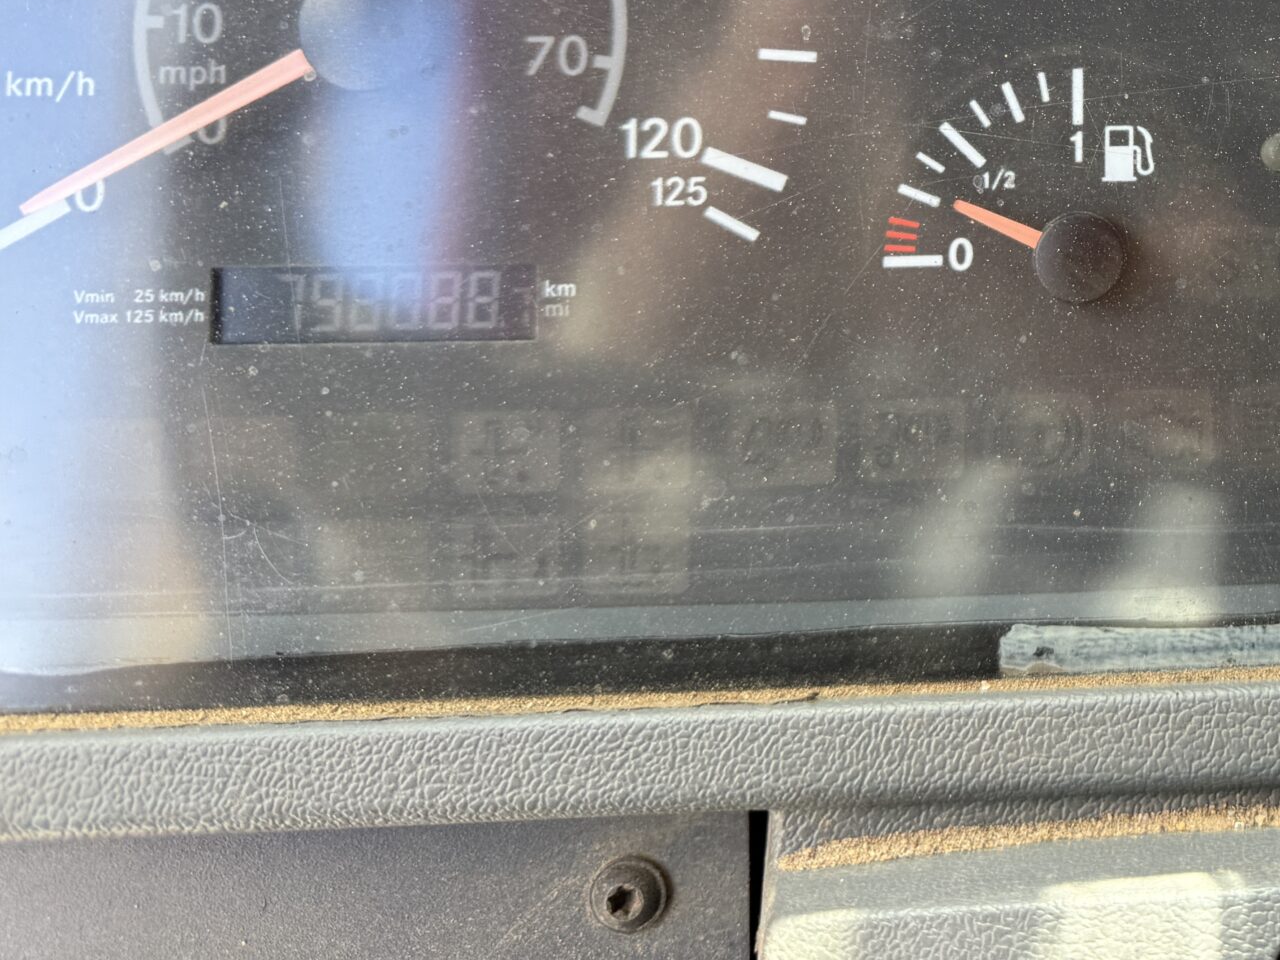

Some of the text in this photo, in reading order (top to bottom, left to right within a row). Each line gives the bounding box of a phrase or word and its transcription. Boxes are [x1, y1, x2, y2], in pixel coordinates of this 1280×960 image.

[168, 3, 223, 44] 10
[526, 37, 588, 76] 70
[6, 70, 96, 103] km/h
[159, 59, 227, 91] mph
[620, 118, 703, 160] 120
[1069, 131, 1083, 163] 1
[651, 177, 708, 207] 125
[981, 167, 1017, 191] 1/2
[948, 237, 974, 272] 0
[73, 288, 206, 305] Vmin 25 km/h
[544, 280, 577, 298] km
[73, 308, 206, 326] Vmax 125 km/h
[544, 299, 571, 318] mi
